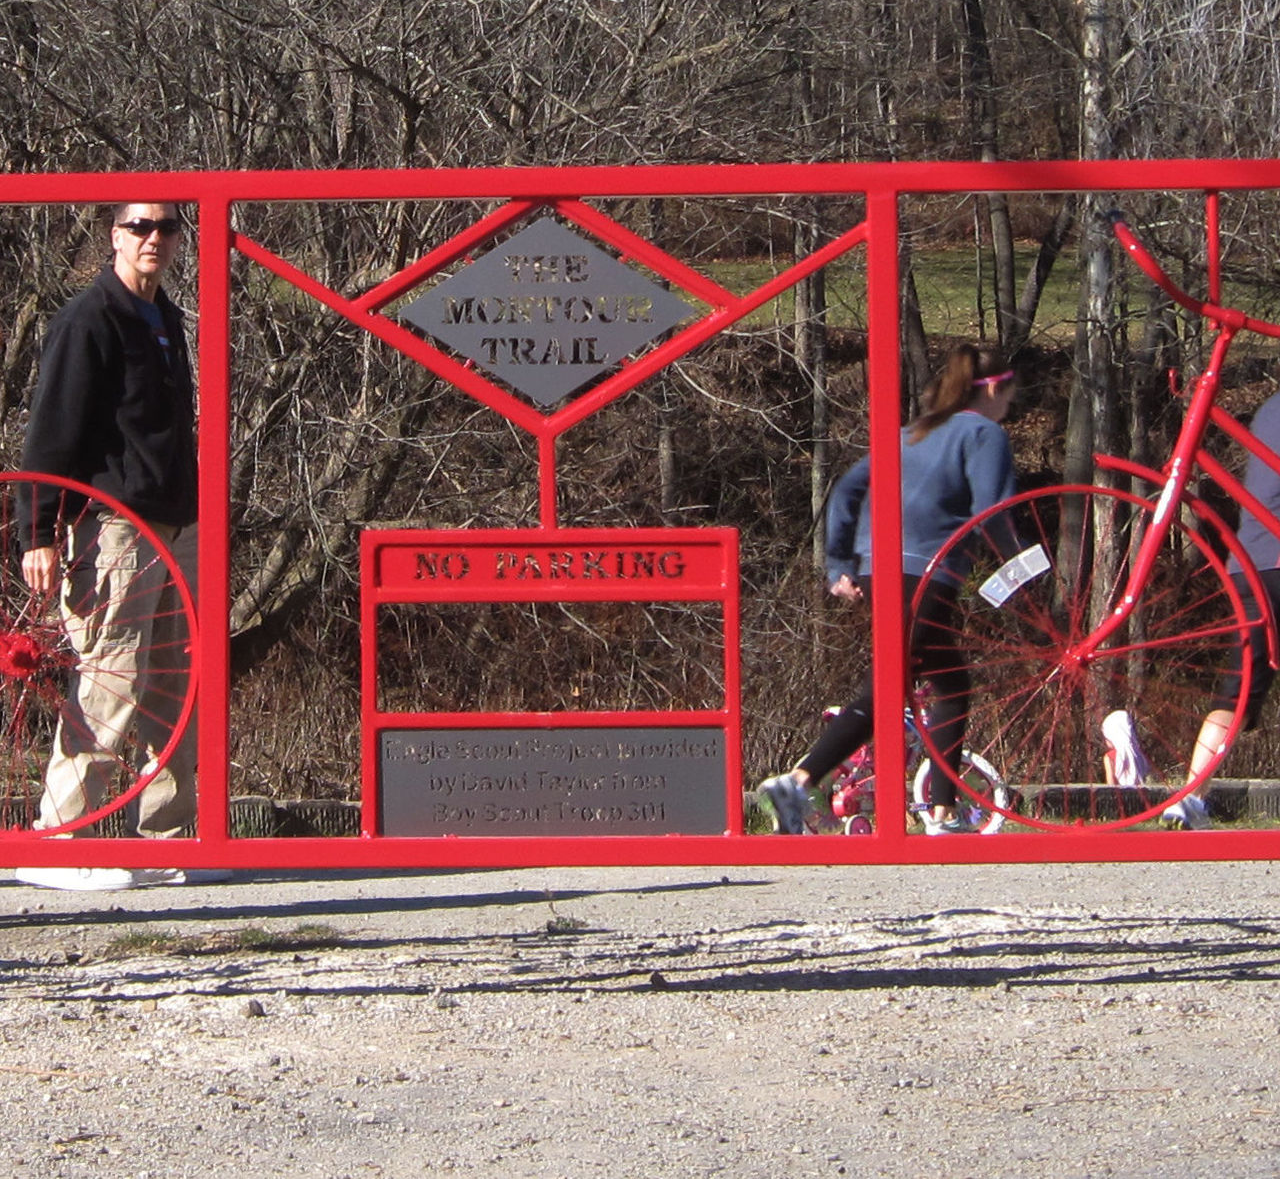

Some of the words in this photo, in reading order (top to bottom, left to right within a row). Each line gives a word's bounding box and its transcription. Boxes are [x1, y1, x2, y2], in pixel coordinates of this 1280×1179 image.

[503, 255, 590, 284] THE
[441, 295, 653, 325] MONTOUR
[481, 336, 609, 365] TRAIL
[413, 552, 470, 581] NO
[494, 551, 687, 580] PARKING
[386, 740, 451, 765] Eagle
[456, 739, 521, 760] Scout
[526, 738, 611, 764] Project
[617, 737, 718, 763] provided
[429, 773, 457, 796] by
[462, 772, 528, 792] David
[537, 771, 606, 796] Taylor
[611, 771, 667, 790] from
[433, 802, 476, 826] Boy
[484, 802, 548, 822] Scout
[554, 801, 623, 826] Troop
[628, 801, 666, 822] 301
